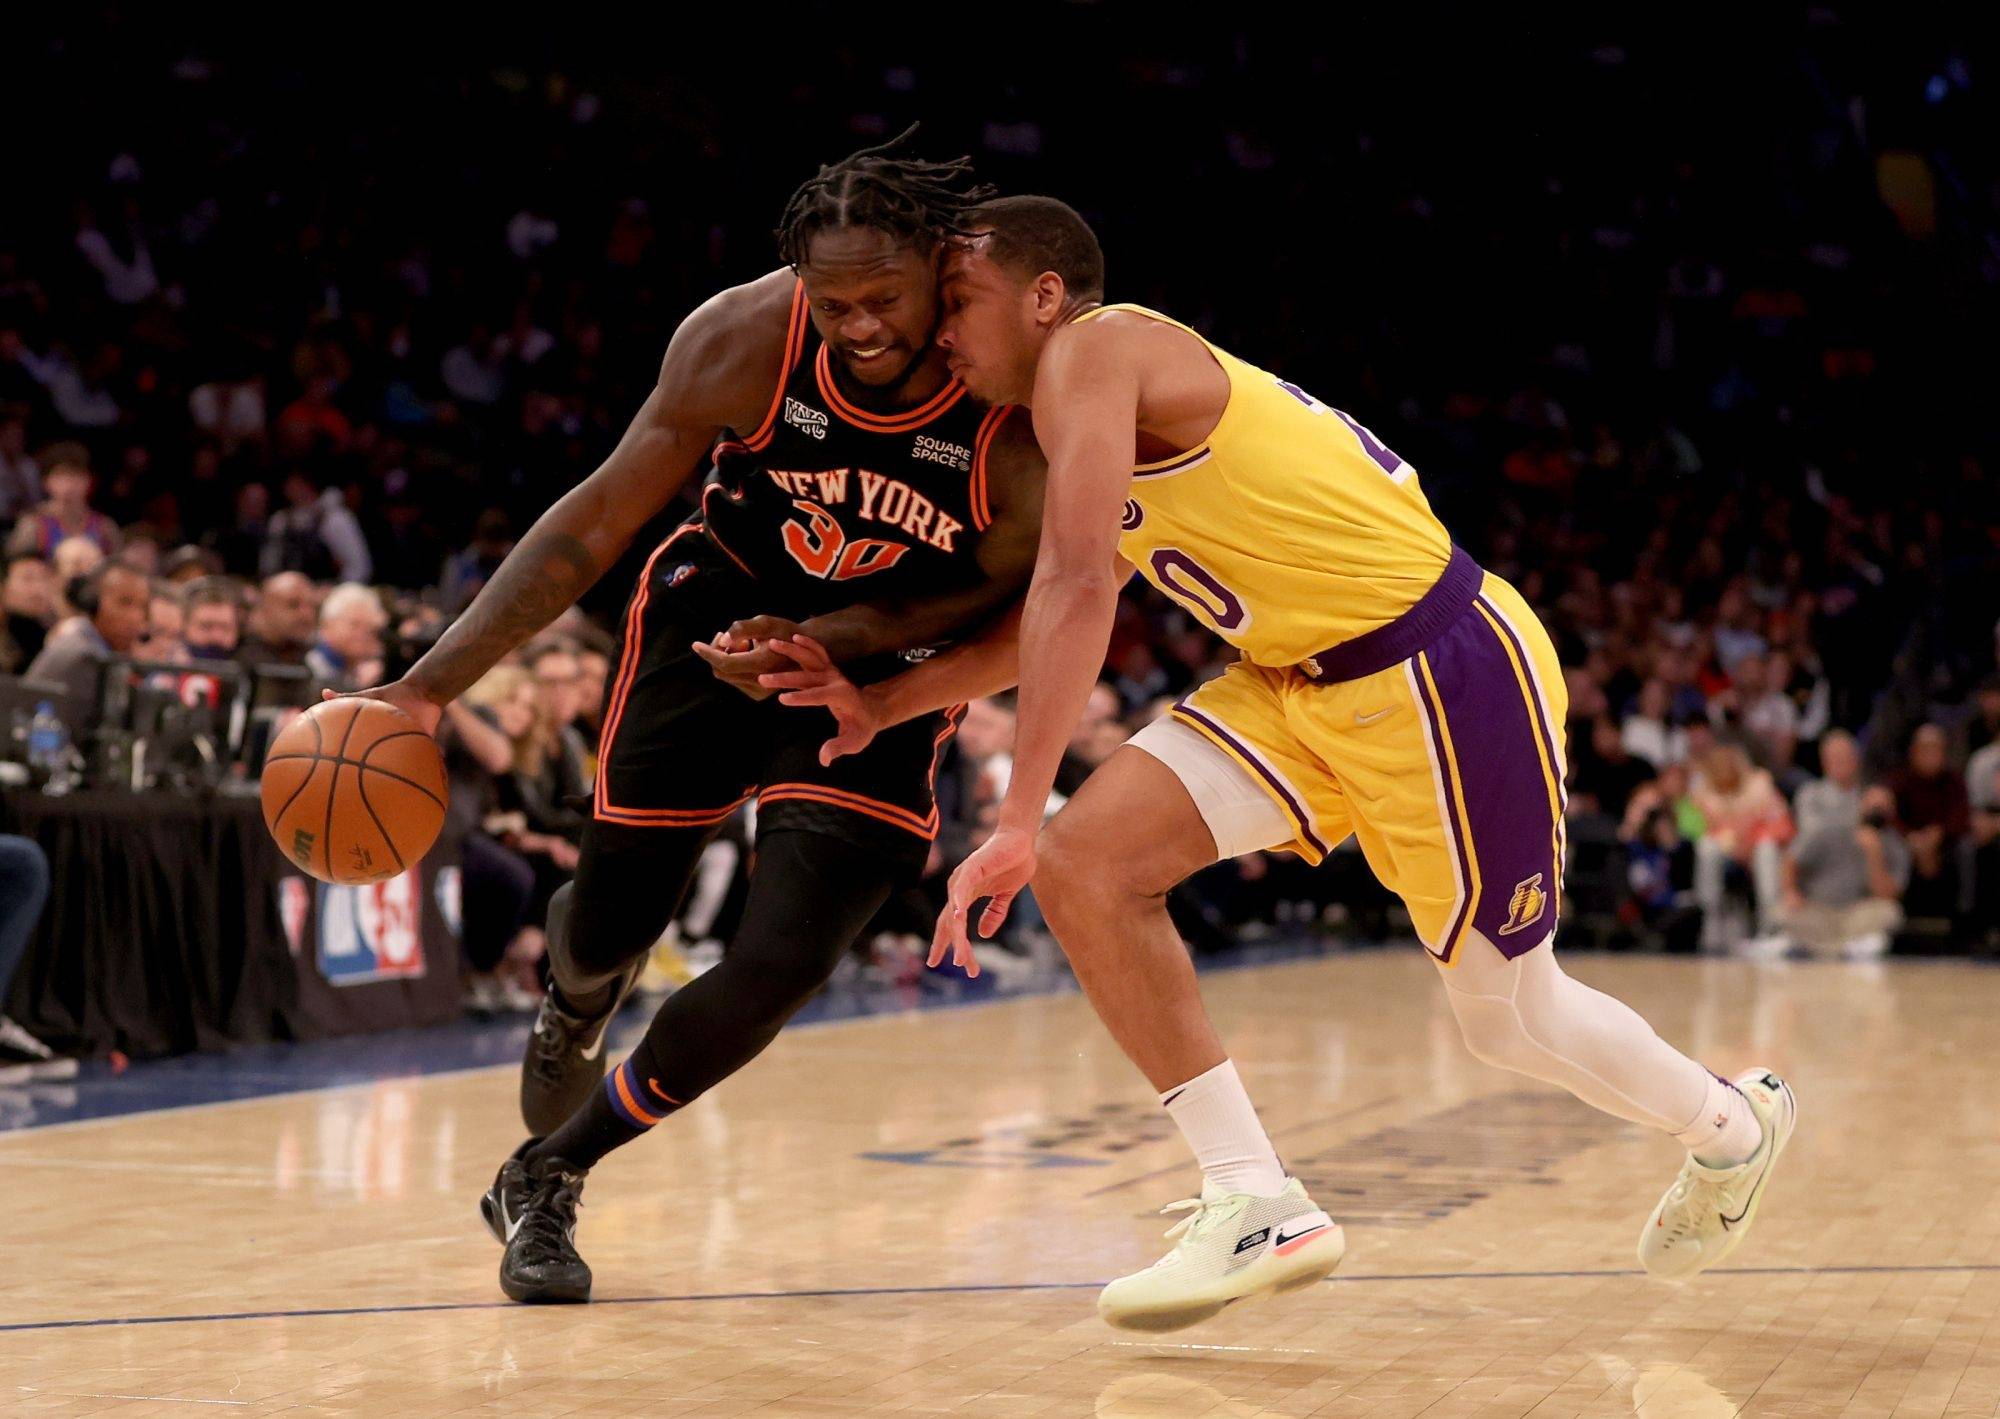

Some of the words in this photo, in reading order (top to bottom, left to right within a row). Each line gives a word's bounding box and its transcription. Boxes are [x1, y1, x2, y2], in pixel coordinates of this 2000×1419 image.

[911, 447, 958, 468] SPACE
[915, 435, 971, 461] SQUARE
[857, 468, 964, 553] YORK
[780, 499, 911, 581] 30
